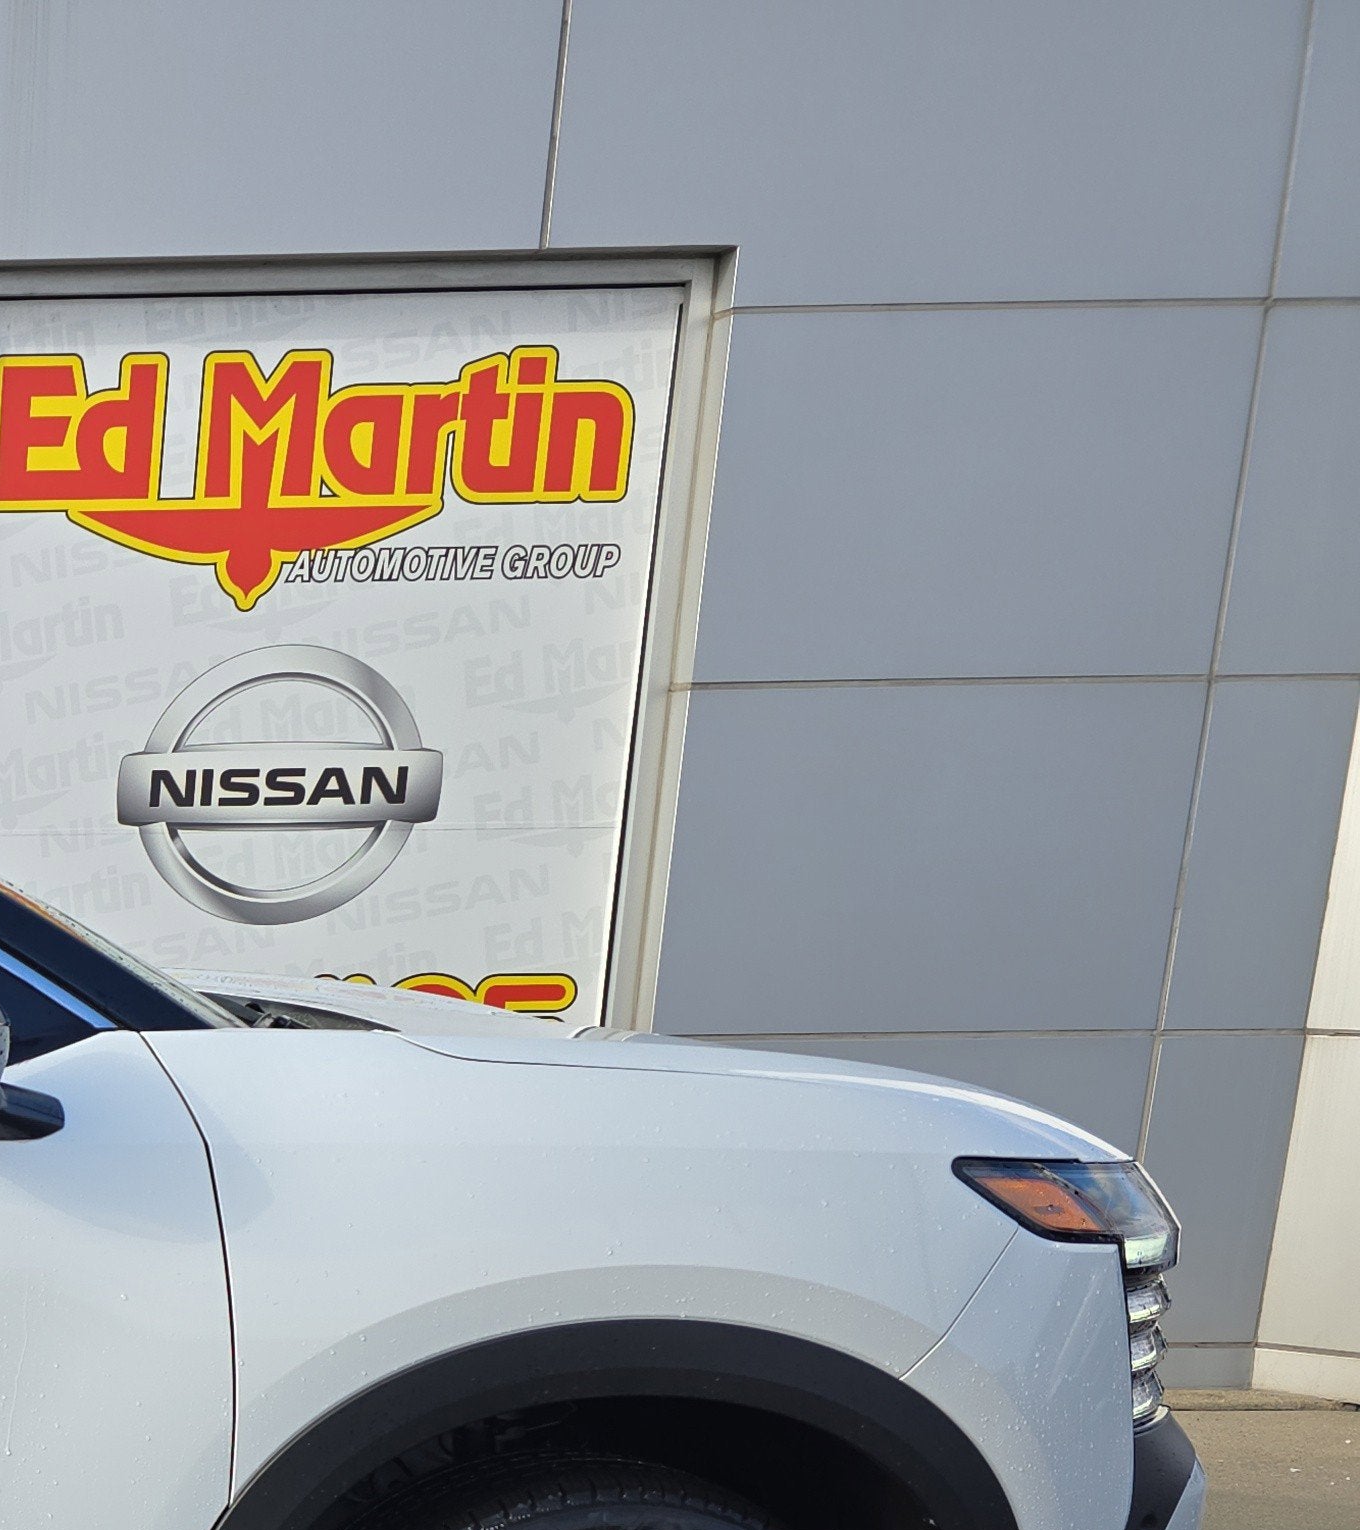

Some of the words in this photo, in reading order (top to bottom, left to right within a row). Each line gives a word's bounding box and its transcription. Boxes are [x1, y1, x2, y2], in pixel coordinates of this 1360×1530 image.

[195, 345, 636, 512] Martin
[283, 546, 499, 583] AUTOMOTIVE
[501, 543, 622, 581] GROUP
[25, 655, 223, 725] NISSA
[149, 766, 409, 809] NISSAN
[25, 864, 153, 918] artin
